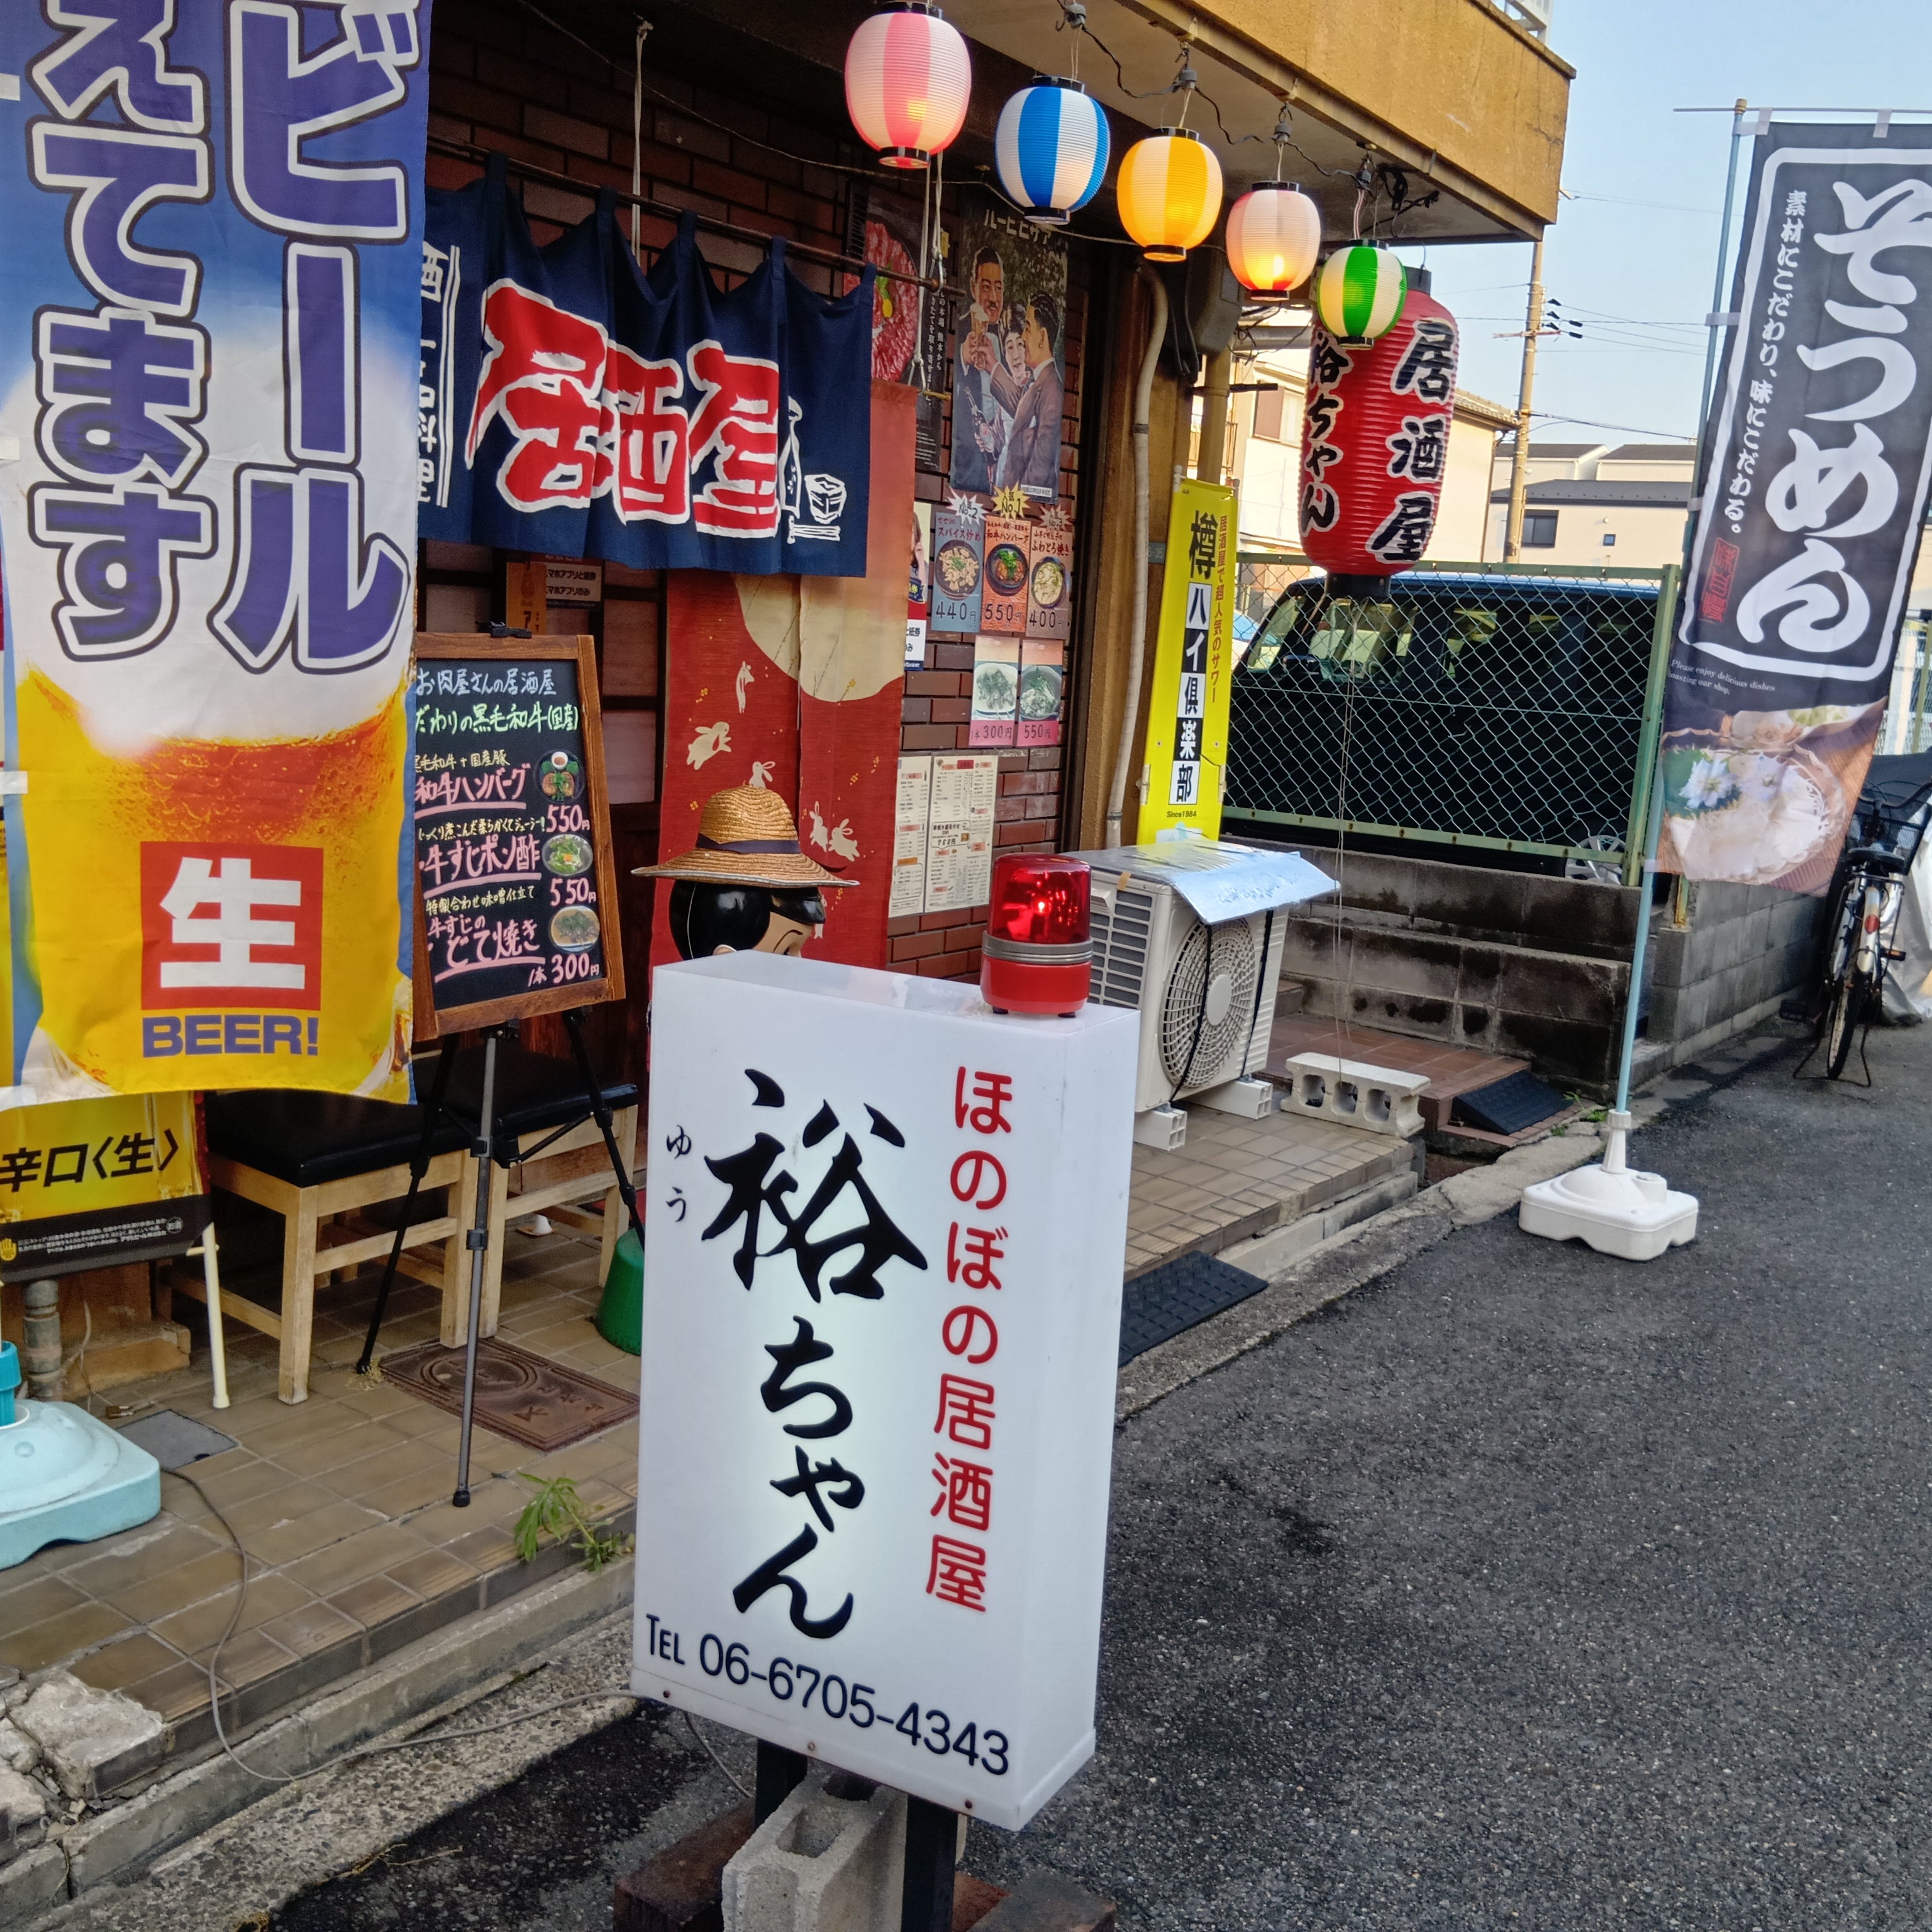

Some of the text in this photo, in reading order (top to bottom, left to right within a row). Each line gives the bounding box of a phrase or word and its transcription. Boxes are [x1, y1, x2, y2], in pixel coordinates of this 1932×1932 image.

[465, 279, 781, 538] 居酒屋
[1724, 189, 1807, 533] 素材にこだわり、味にこだわる。
[1736, 179, 1932, 653] そうめん
[1367, 319, 1455, 563] 居酒屋
[1177, 510, 1218, 802] 樽ハイ倶楽部
[1211, 515, 1228, 702] 居酒屋で超人気のサワー
[1670, 660, 1776, 692] Please enjoy delicious dishes
[417, 667, 557, 696] お肉屋さんの居酒屋
[415, 763, 531, 805] 和牛ハンバーグ
[546, 804, 590, 833] 550円
[160, 857, 306, 989] 生
[424, 834, 540, 884] 牛すじポン酢
[550, 878, 596, 906] 550円
[142, 1014, 319, 1058] BEER!
[701, 1069, 928, 1639] 裕ちゃん
[926, 1066, 1012, 1613] ほのぼの居酒屋
[699, 1633, 1009, 1776] 06-6705-4343
